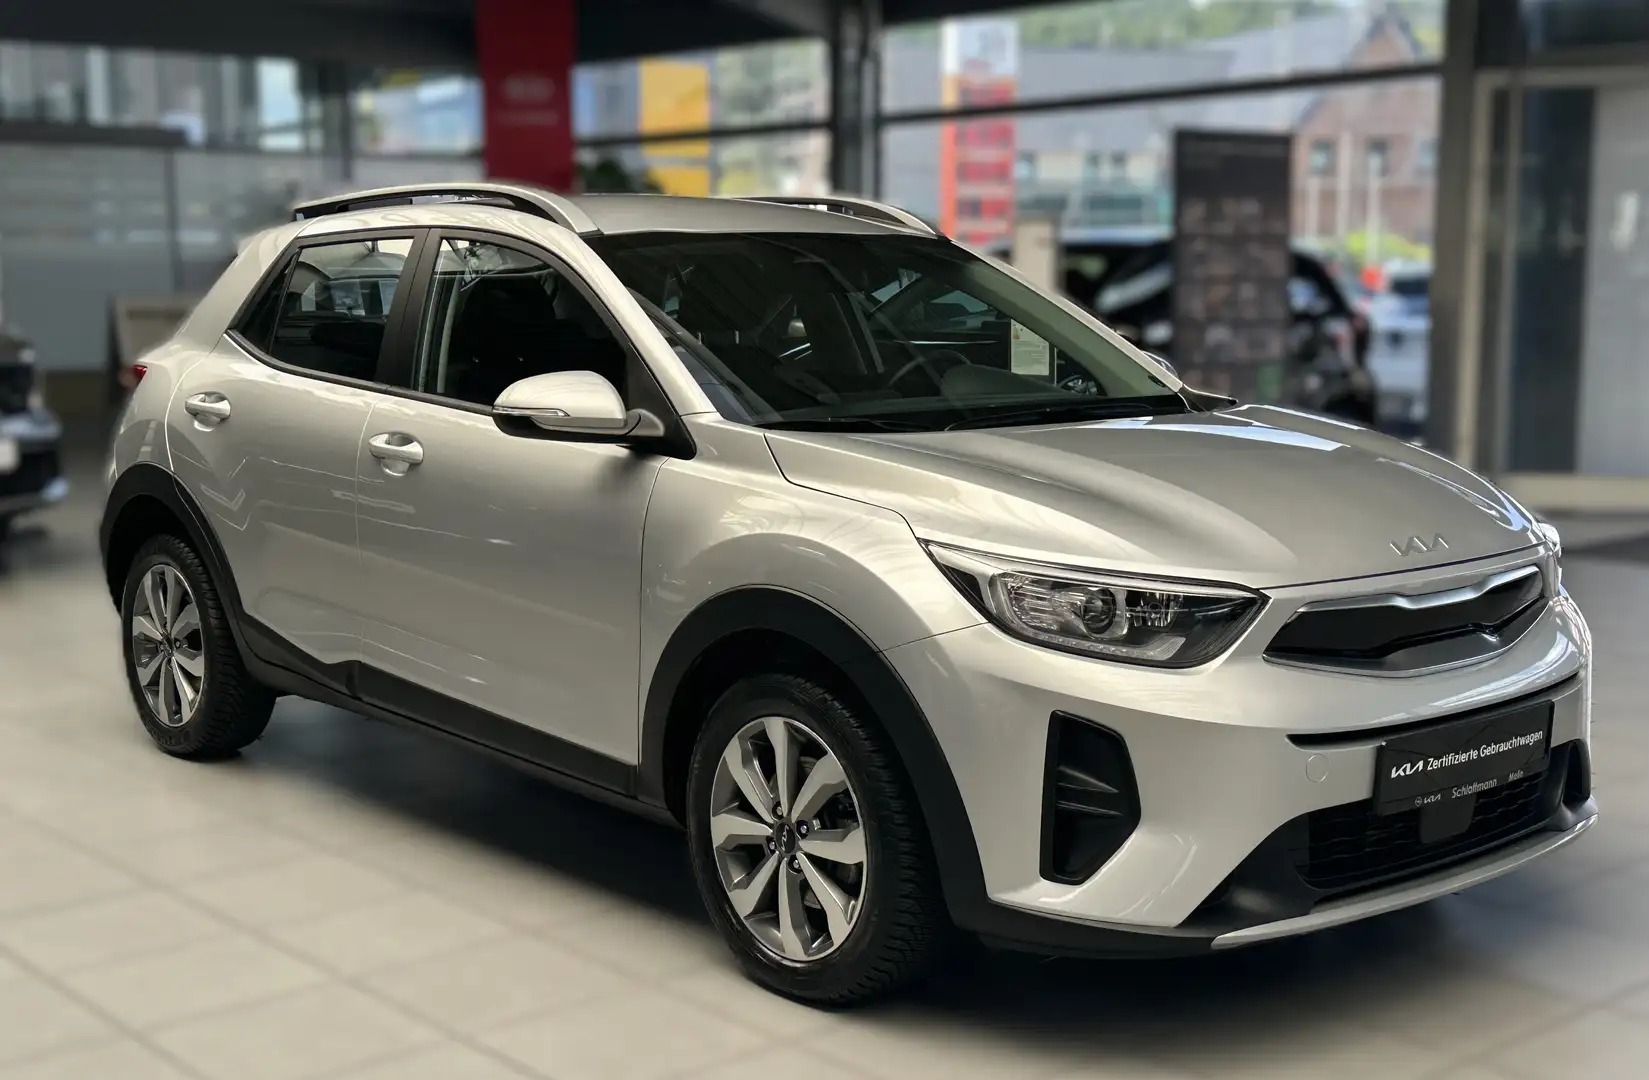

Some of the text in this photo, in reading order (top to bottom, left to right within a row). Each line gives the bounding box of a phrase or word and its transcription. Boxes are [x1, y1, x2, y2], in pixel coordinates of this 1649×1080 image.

[1389, 532, 1449, 557] KIA
[1391, 730, 1543, 778] KIA Zertifizierte Gebrauchtwagen
